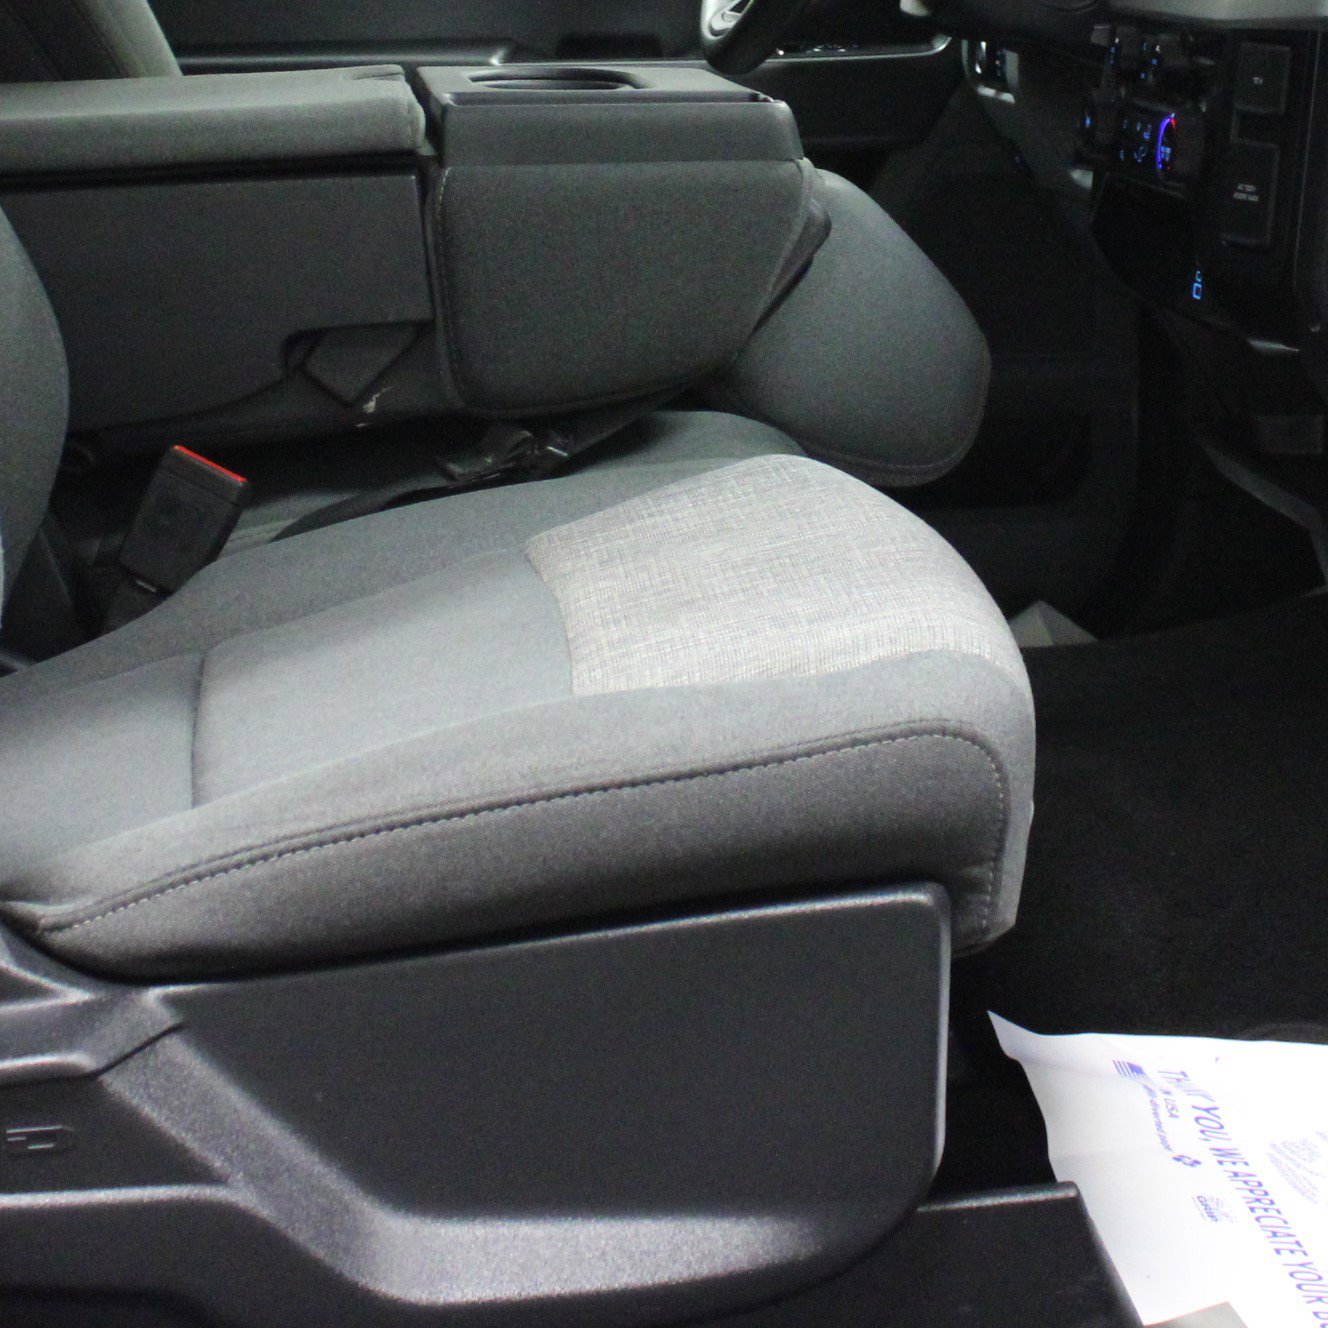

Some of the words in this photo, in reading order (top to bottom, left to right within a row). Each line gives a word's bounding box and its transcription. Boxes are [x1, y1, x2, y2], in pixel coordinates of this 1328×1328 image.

[1158, 1070, 1217, 1104] THK
[1190, 1104, 1233, 1142] YOU,
[1208, 1147, 1251, 1167] WE
[1222, 1169, 1309, 1257] APPRECIATE
